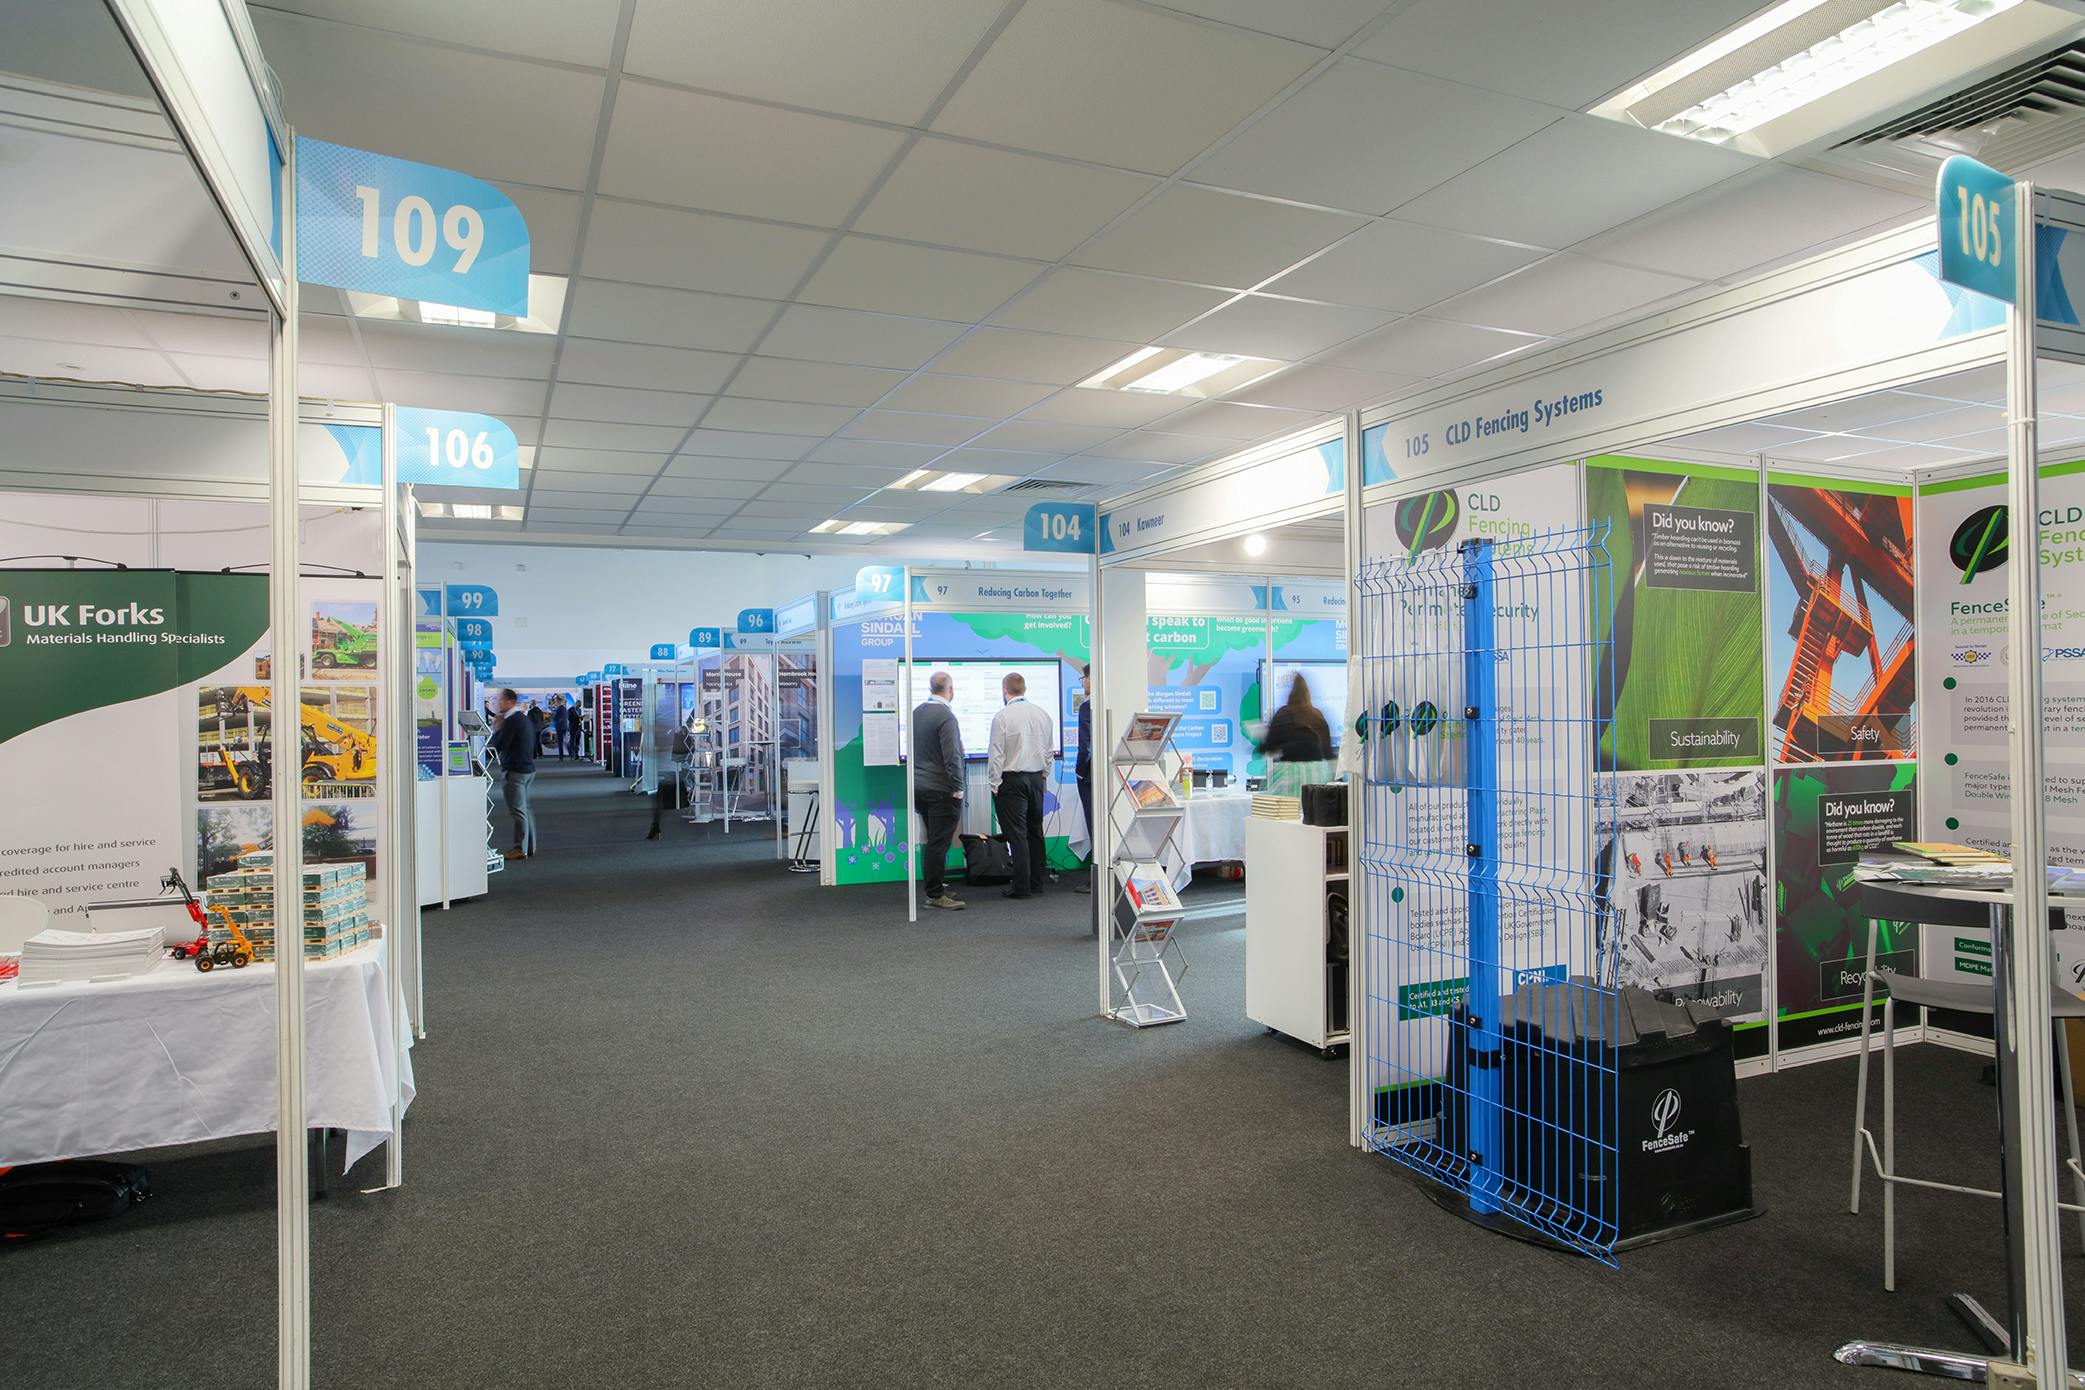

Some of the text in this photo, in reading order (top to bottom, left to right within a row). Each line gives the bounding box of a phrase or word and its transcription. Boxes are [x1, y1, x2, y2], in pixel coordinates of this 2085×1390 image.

[356, 185, 484, 273] 109
[1958, 186, 2002, 267] 105
[1405, 388, 1603, 457] 105 CLD Fencing Systems
[425, 427, 494, 469] 106
[1467, 493, 1501, 512] CLD
[1652, 512, 1734, 533] Did you know?
[2039, 507, 2082, 526] CLD
[1041, 513, 1081, 541] 104
[1119, 521, 1130, 538] 104
[1469, 515, 1530, 538] Fencing
[871, 574, 892, 593] 97
[462, 592, 483, 609] 99
[937, 586, 1073, 600] 97 Reducing Carbon Together
[1292, 595, 1301, 604] 95
[24, 602, 165, 626] UK Forks
[748, 614, 763, 627] 96
[467, 623, 482, 636] 98
[861, 622, 921, 633] SINDAL
[1152, 616, 1205, 629] speak to
[26, 632, 225, 645] Materials Handling Specialists
[698, 632, 711, 643] 89
[861, 638, 894, 646] GROUP
[1153, 632, 1197, 643] carbon
[472, 650, 484, 659] 90
[657, 648, 668, 656] 88
[1963, 715, 1999, 723] provided
[1670, 729, 1740, 749] Sustainability
[1850, 725, 1880, 743] Safety
[1964, 772, 2006, 781] FenceSafe
[1965, 783, 1987, 791] major
[2049, 786, 2074, 794] Mesh
[1965, 791, 2078, 804] Double Mesh
[1825, 798, 1895, 819] Did you know?
[1, 838, 157, 856] coverage for hire and service
[1965, 838, 2001, 848] Certified
[2062, 846, 2078, 854] the
[42, 864, 85, 874] account
[88, 860, 141, 871] managers
[17, 887, 38, 896] hire
[41, 885, 62, 894] and
[65, 882, 104, 893] service
[107, 880, 141, 890] centre
[53, 905, 74, 915] and
[1959, 962, 1979, 971] MDPE
